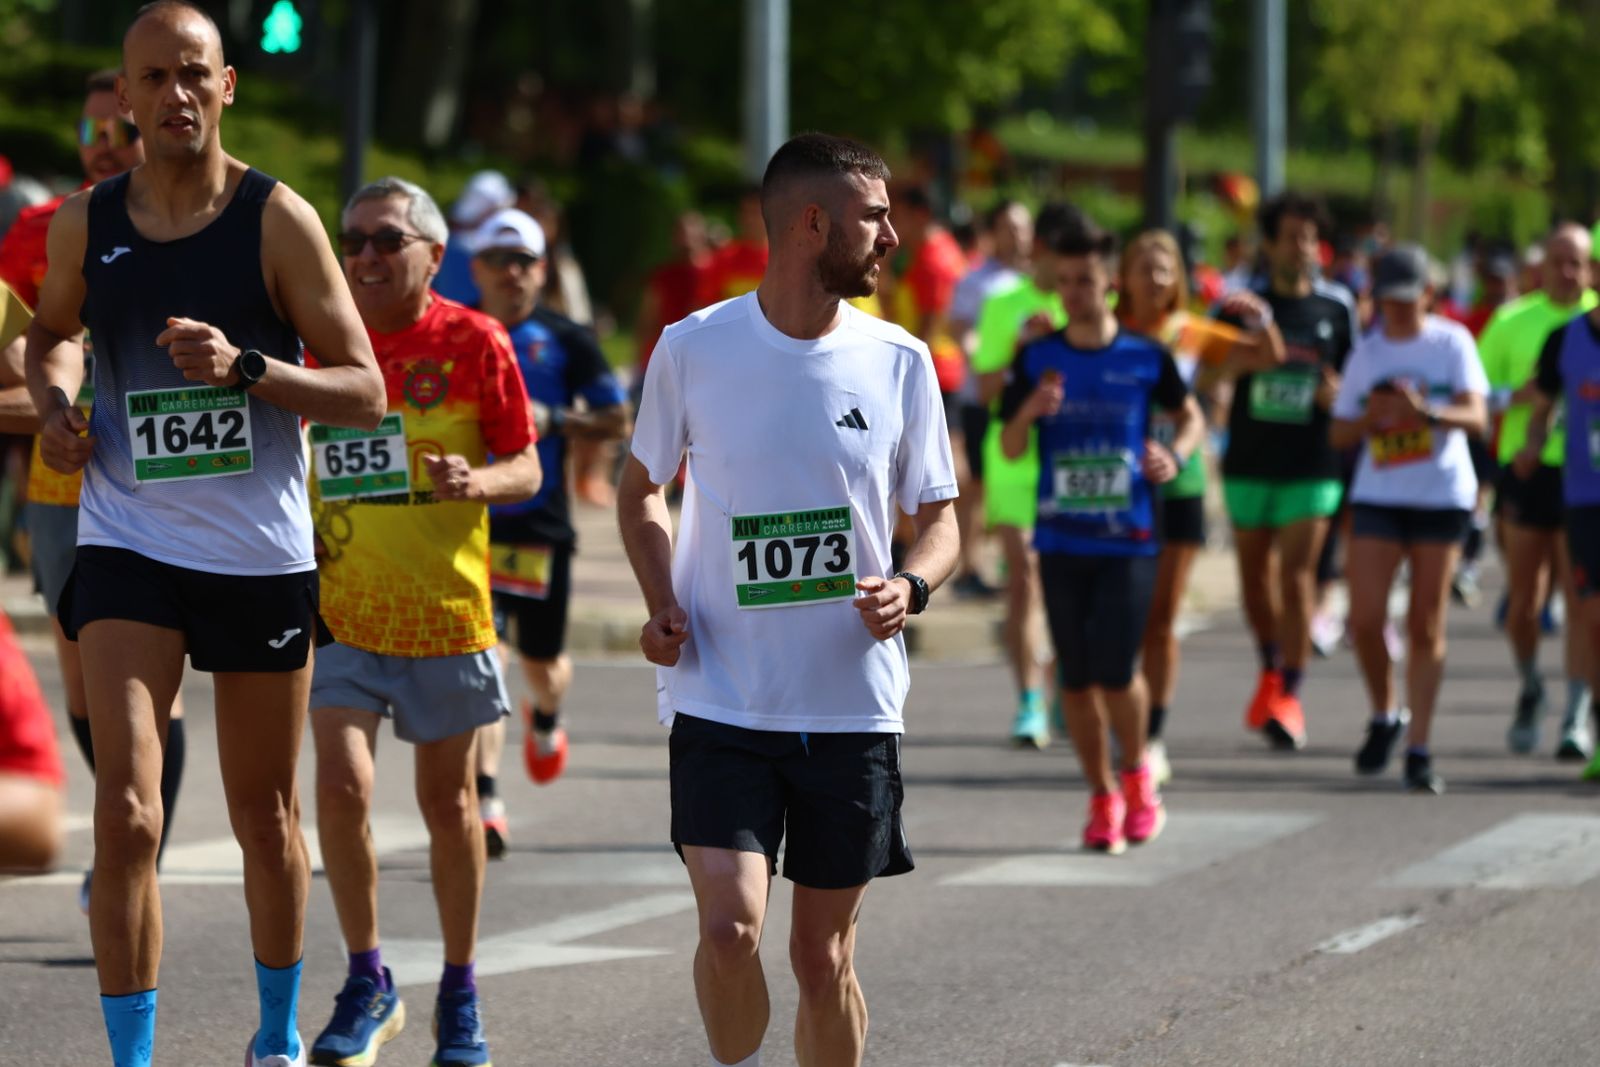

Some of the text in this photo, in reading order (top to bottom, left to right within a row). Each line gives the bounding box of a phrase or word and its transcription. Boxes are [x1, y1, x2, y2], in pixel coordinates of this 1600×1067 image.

[131, 394, 158, 413] XIV
[161, 399, 214, 412] CARRERA
[136, 410, 247, 456] 1642
[324, 439, 391, 477] 655
[735, 518, 760, 537] XIV
[763, 521, 820, 536] CARRERA
[738, 533, 851, 581] 1073
